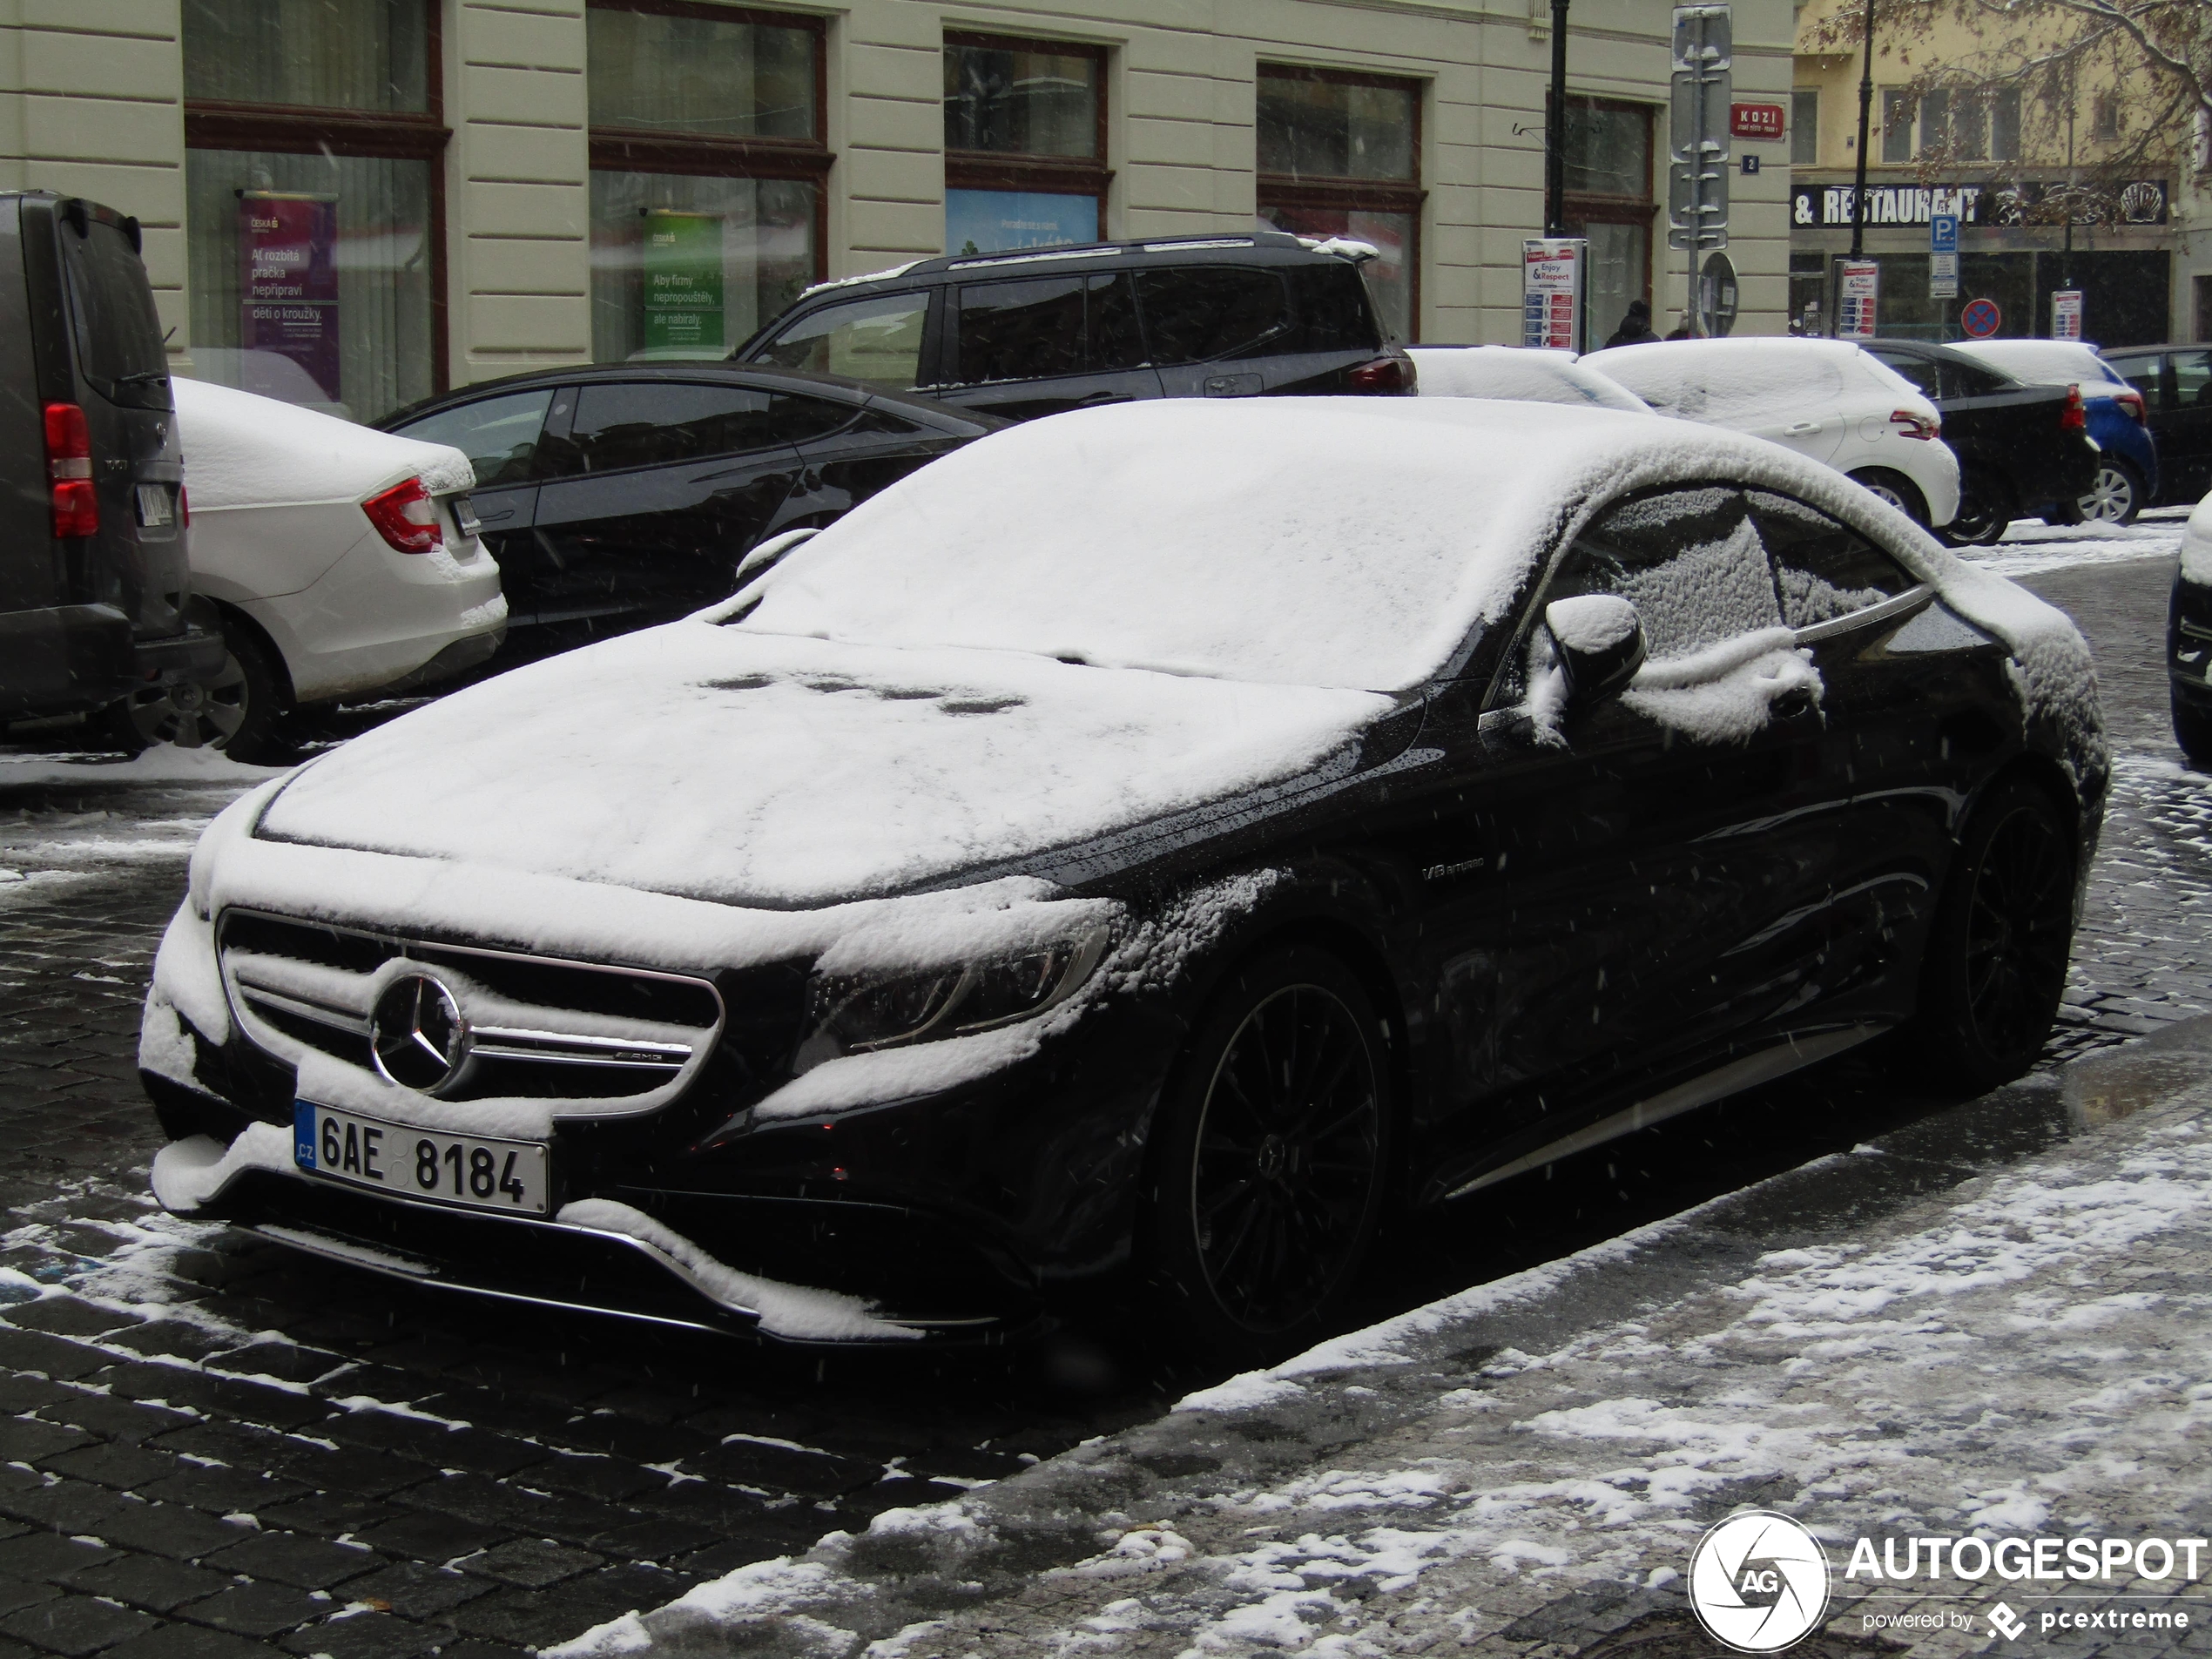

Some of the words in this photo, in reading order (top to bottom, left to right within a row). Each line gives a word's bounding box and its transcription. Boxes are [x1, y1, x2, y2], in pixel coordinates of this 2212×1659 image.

[1740, 111, 1777, 124] KOZÍ
[1748, 158, 1754, 170] 2
[1794, 194, 1813, 225] &
[1936, 219, 1952, 241] P
[252, 247, 263, 261] Ať
[265, 249, 300, 261] rozbitá
[253, 266, 286, 280] pračka
[1533, 268, 1541, 280] &
[1541, 273, 1569, 281] Respect
[1541, 263, 1561, 273] Enjoy
[653, 274, 670, 288] Aby
[671, 274, 694, 288] firmy
[253, 282, 302, 298] nepřipraví
[653, 291, 715, 305] nepropouštěly,
[253, 307, 272, 320] děti
[273, 310, 280, 320] o
[282, 307, 322, 322] kroužky.
[653, 314, 666, 325] ale
[668, 313, 703, 327] nabíraly.
[1422, 864, 1446, 880] V8
[1447, 858, 1484, 874] BITURBO
[299, 1143, 314, 1161] CZ
[321, 1116, 385, 1180] 6AE
[415, 1137, 525, 1203] 8184
